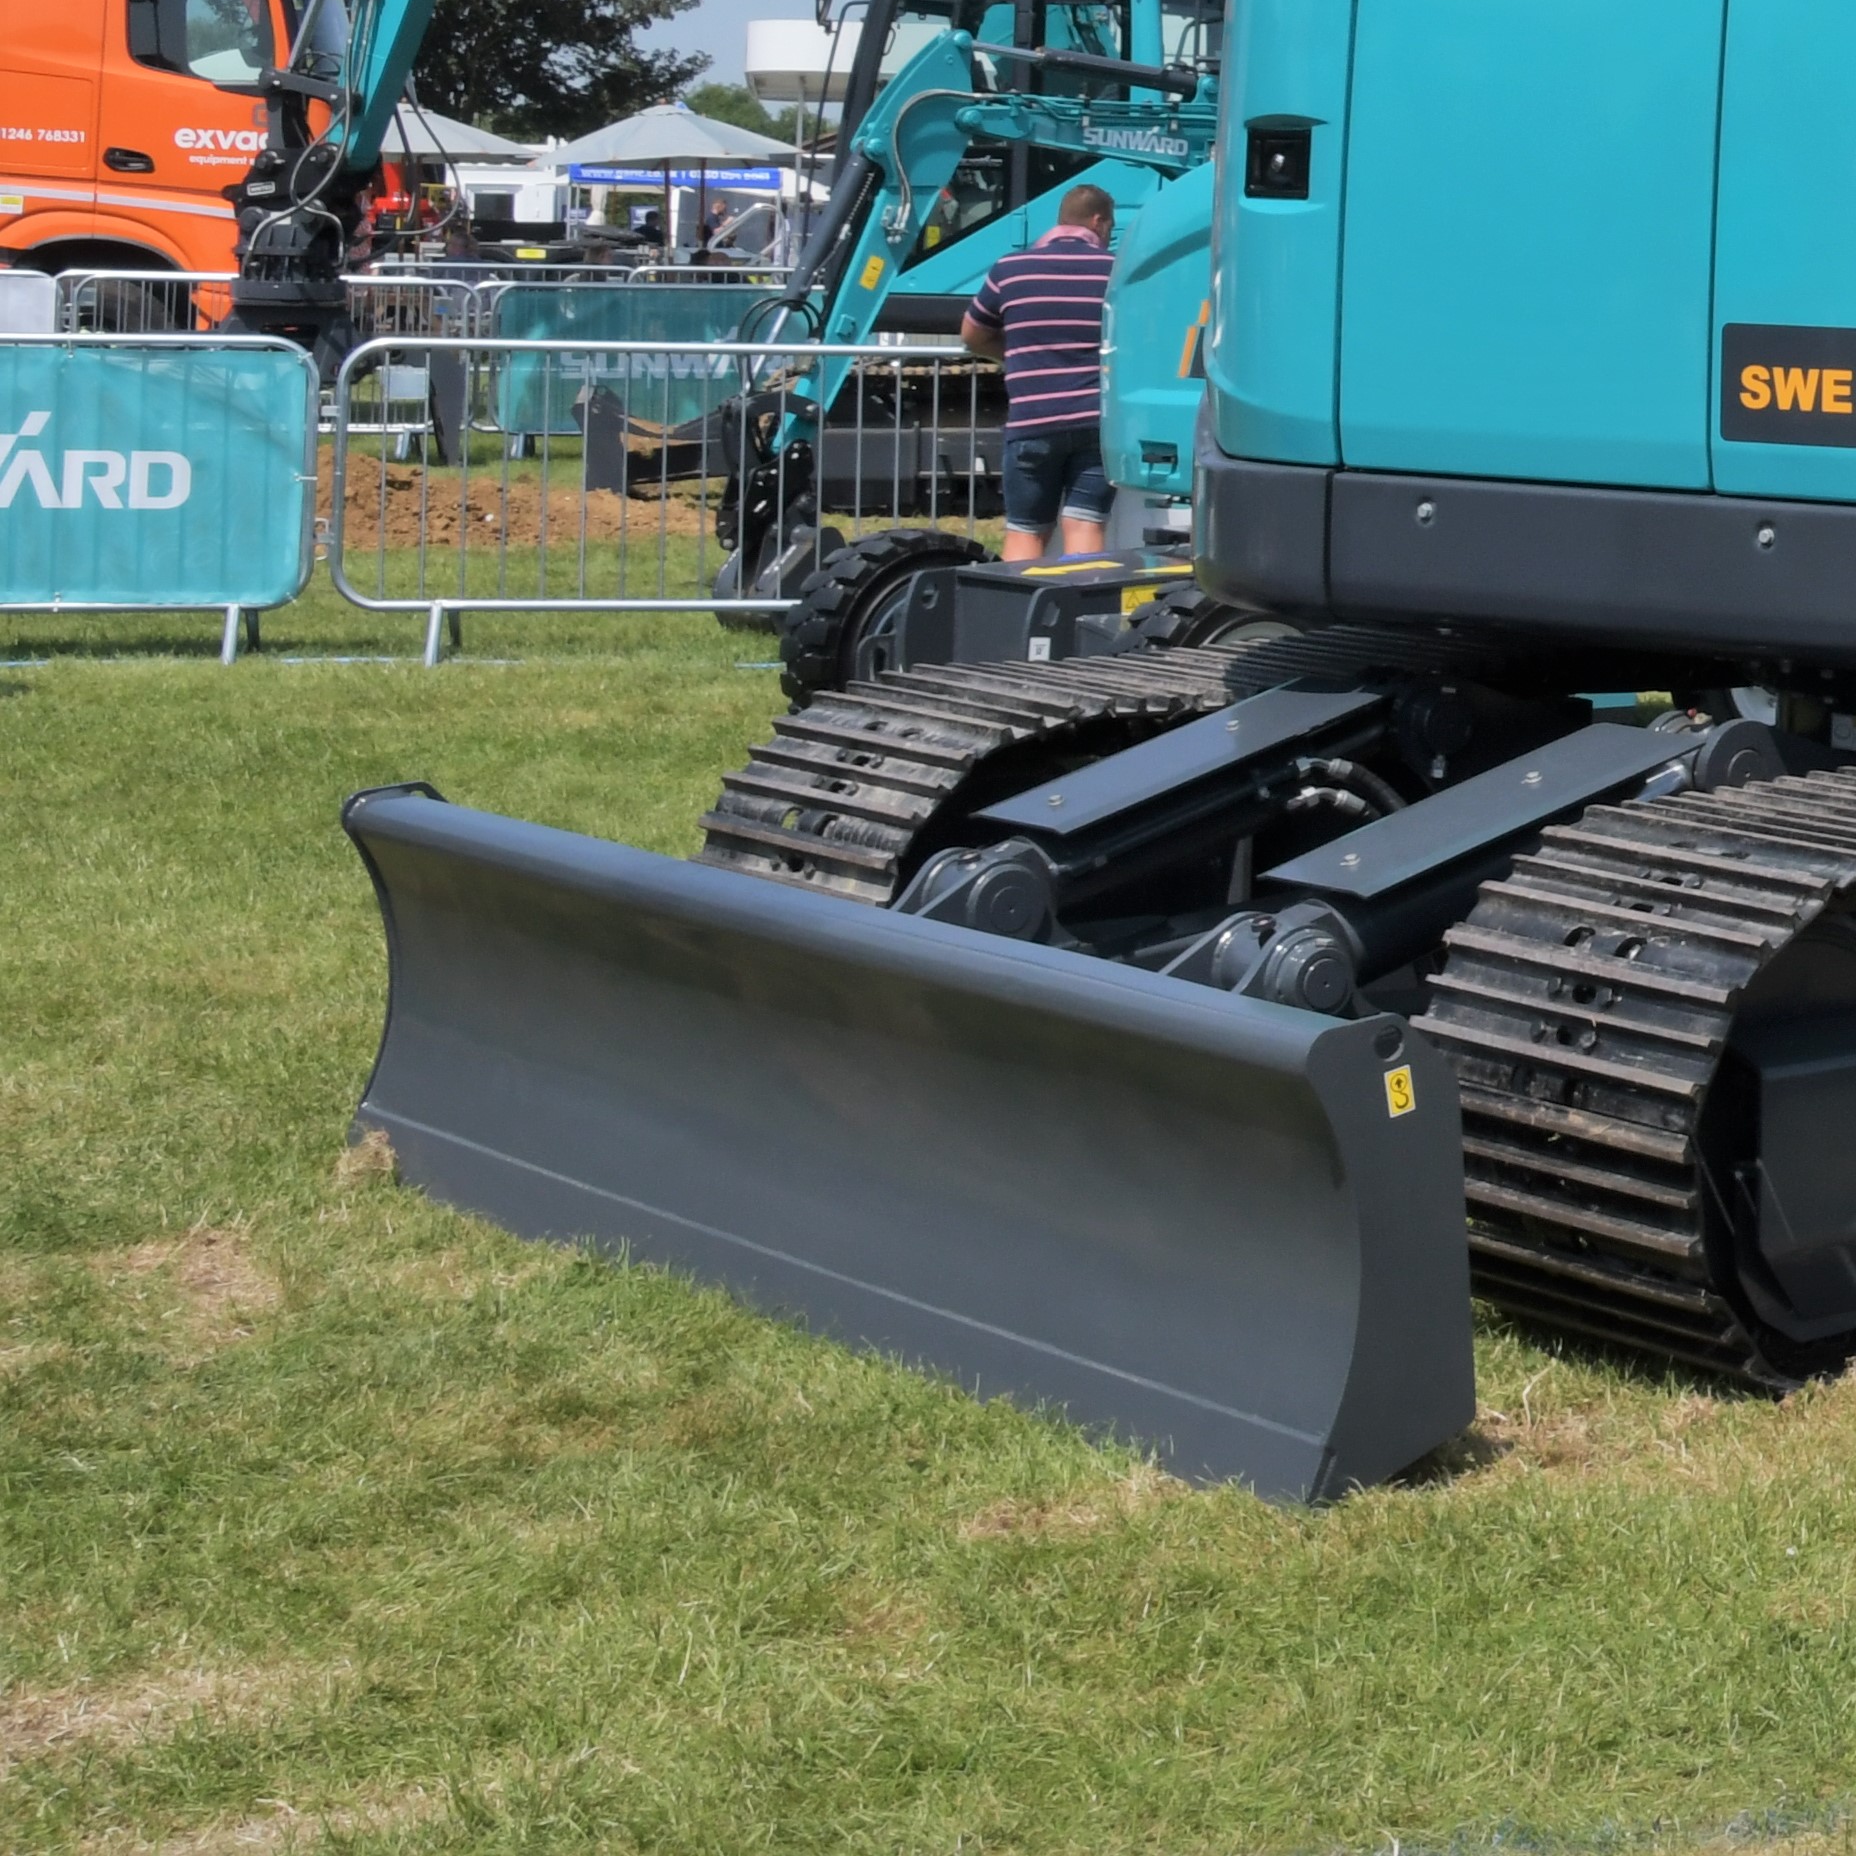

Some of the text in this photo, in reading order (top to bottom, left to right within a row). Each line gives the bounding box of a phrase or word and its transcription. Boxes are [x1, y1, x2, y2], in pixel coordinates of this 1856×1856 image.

[38, 129, 86, 143] 768331
[1083, 126, 1189, 156] SUNWARD
[1739, 364, 1854, 414] SWE
